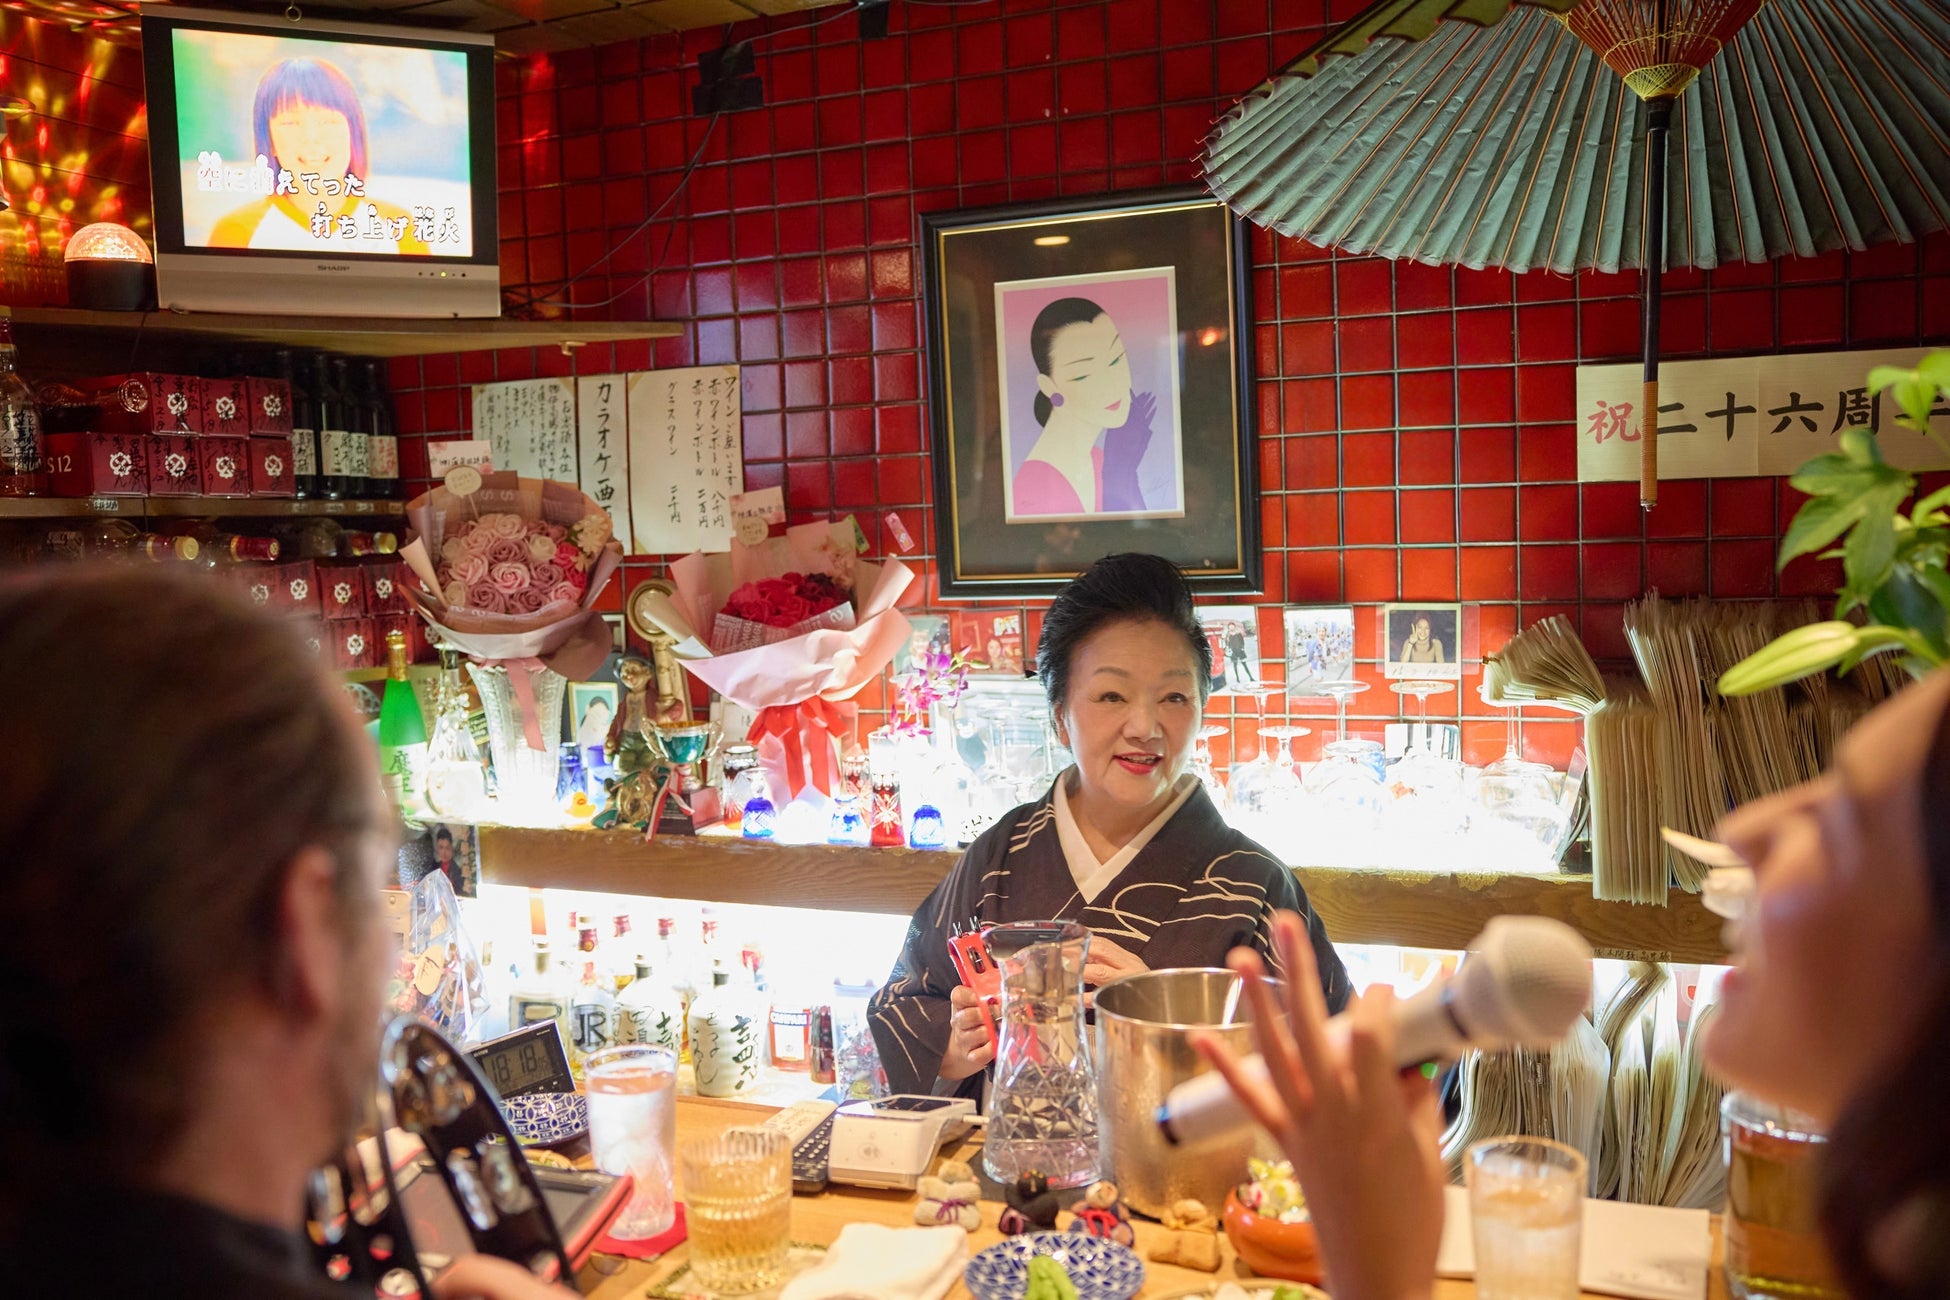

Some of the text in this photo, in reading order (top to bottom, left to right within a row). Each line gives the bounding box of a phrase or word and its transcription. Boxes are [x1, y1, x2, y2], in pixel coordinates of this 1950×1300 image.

[311, 212, 461, 243] 打ち上げ花火
